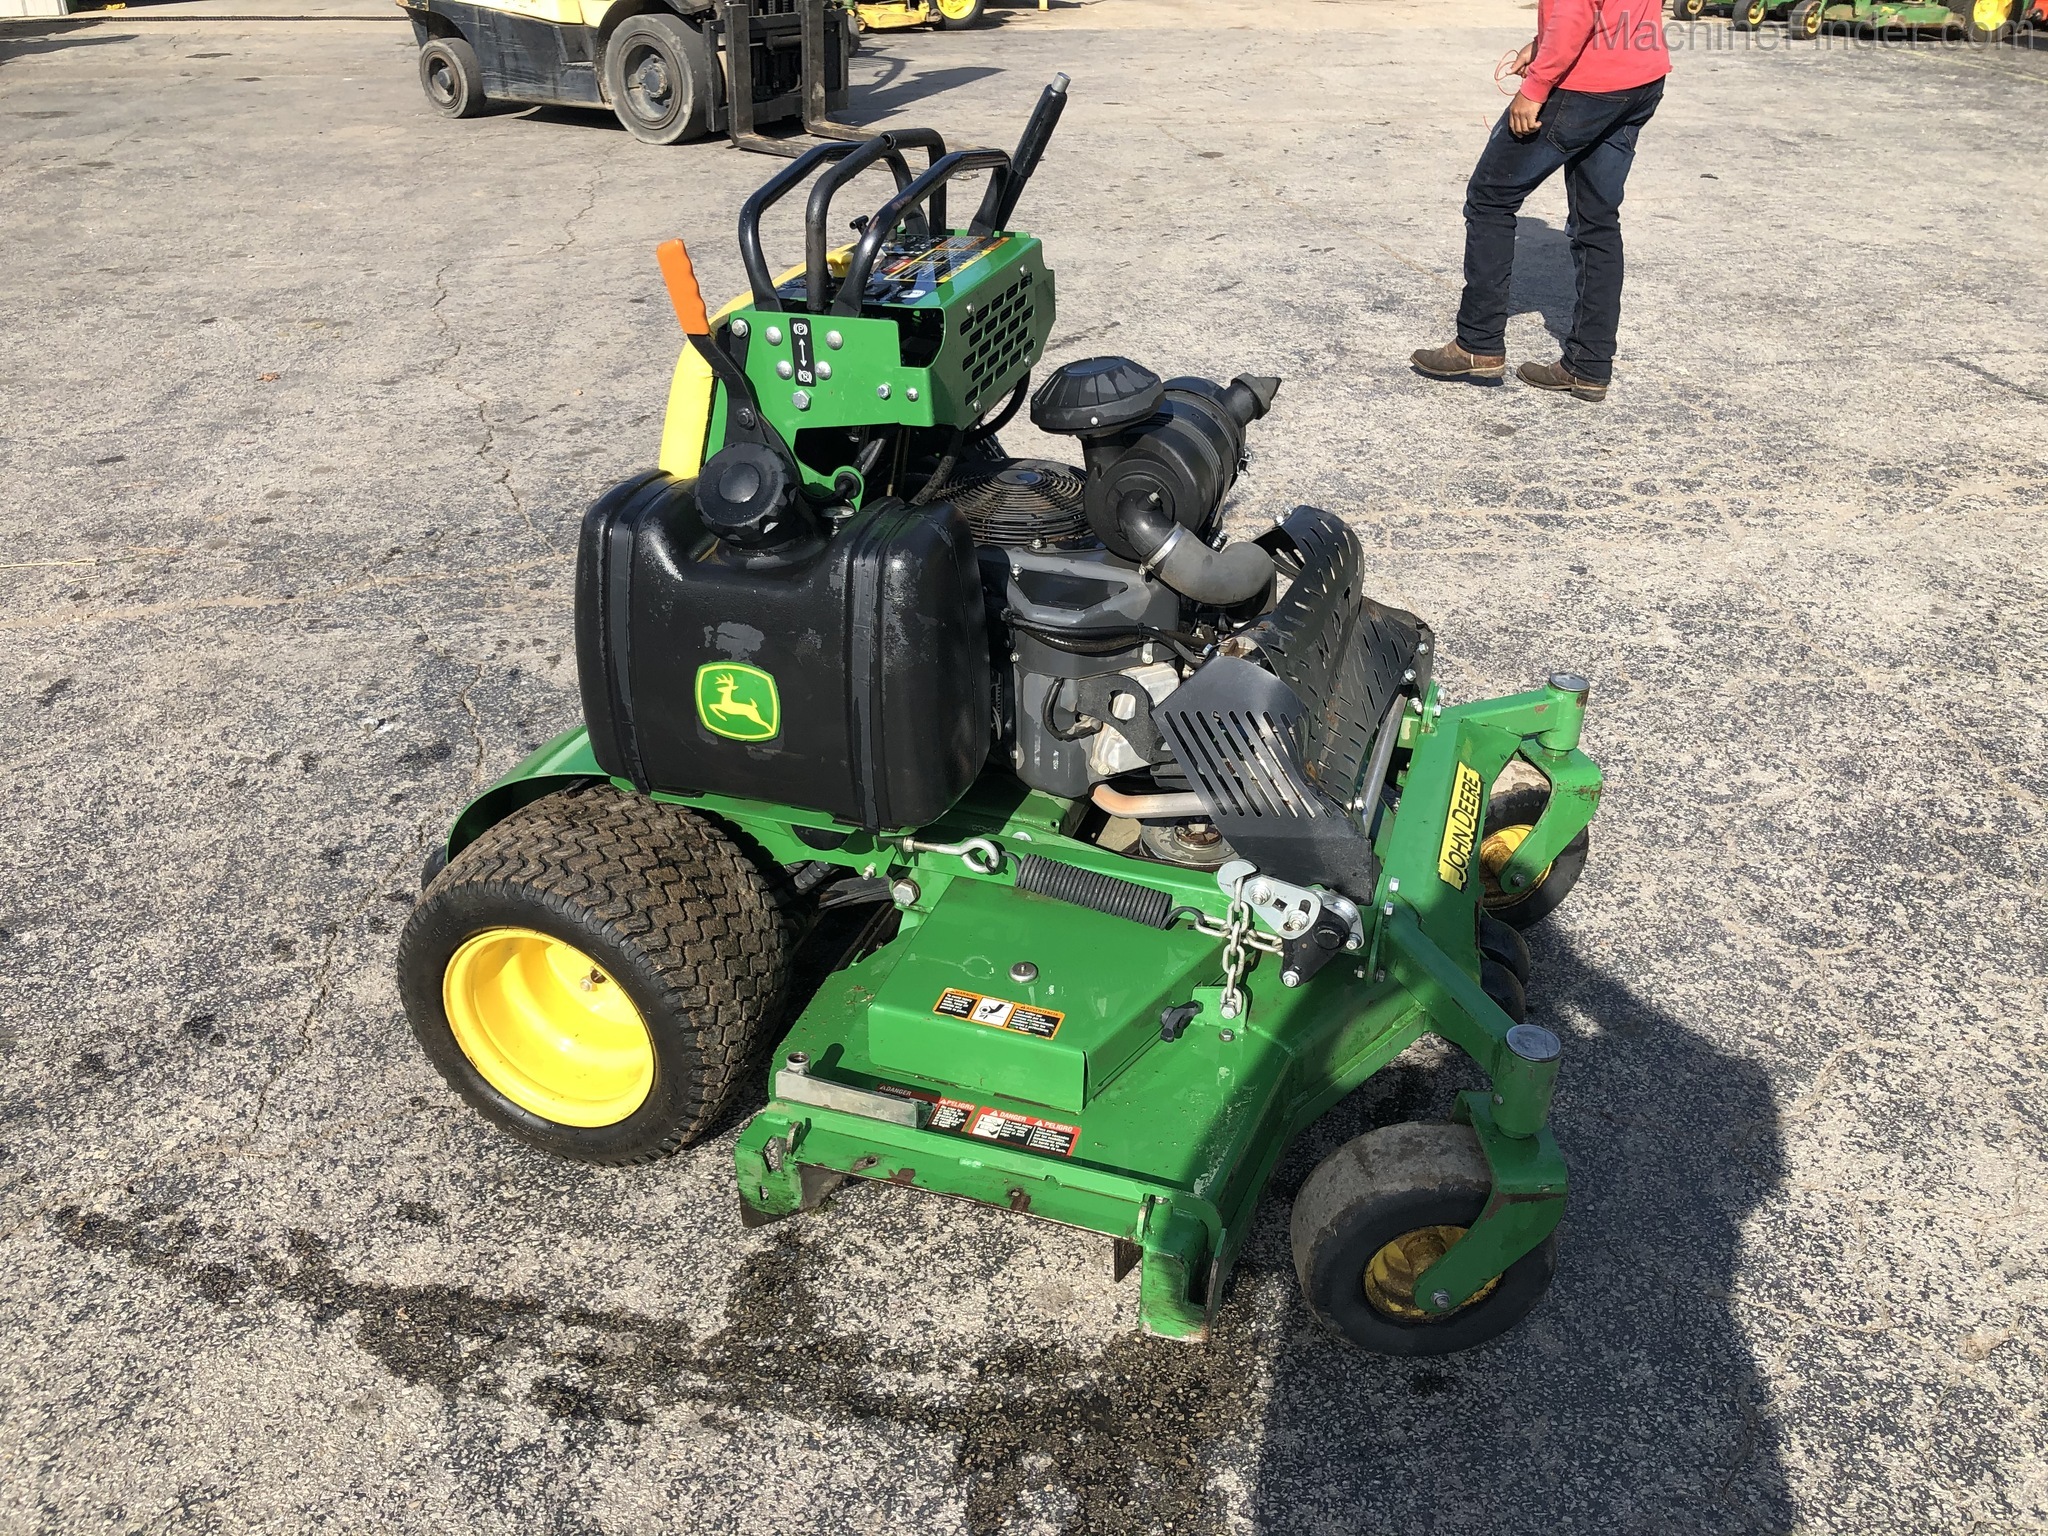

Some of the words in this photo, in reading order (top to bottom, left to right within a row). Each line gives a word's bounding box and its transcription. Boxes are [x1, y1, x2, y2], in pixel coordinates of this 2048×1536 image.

[1452, 772, 1479, 830] DEERE
[1443, 825, 1471, 881] JOHN
[884, 1086, 912, 1096] DANGER
[946, 1100, 975, 1111] PELIGRO
[999, 1111, 1027, 1122] DANGER
[1044, 1121, 1073, 1133] PELIGRO
